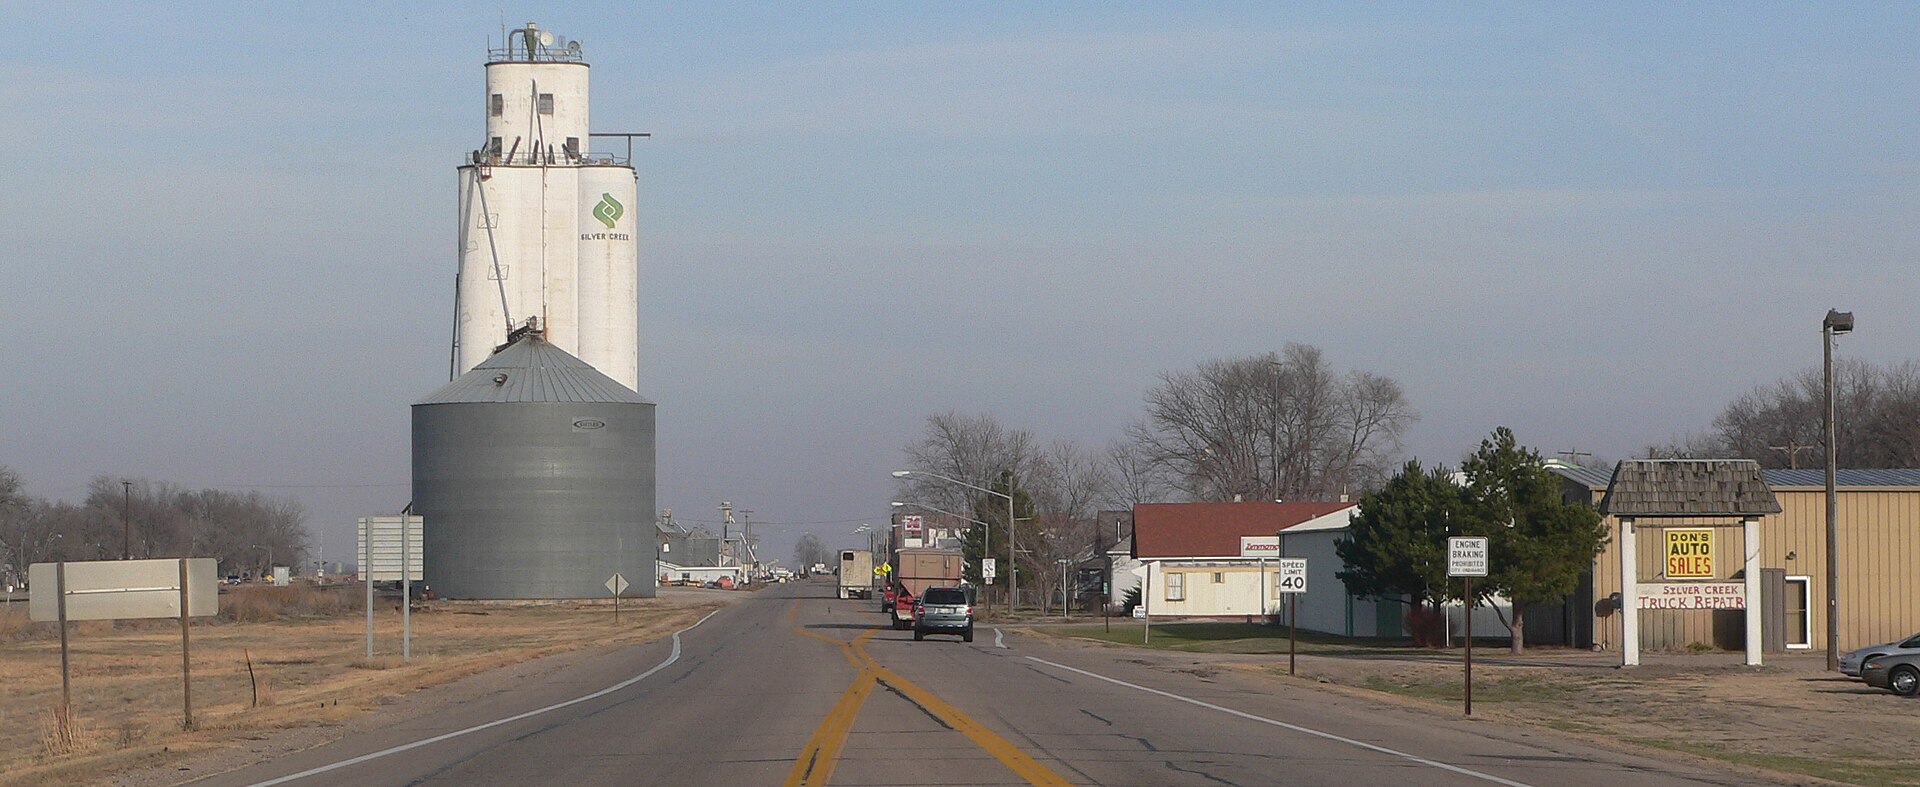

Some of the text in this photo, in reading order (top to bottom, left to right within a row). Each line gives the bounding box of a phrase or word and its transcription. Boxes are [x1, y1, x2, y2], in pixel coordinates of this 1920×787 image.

[581, 233, 629, 241] SILVER CREEK
[1670, 533, 1709, 542] DON'S
[1455, 540, 1481, 548] ENGINE
[1670, 543, 1710, 556] AUTO
[1452, 550, 1484, 559] BRAKING
[1281, 561, 1305, 569] SPEED
[1669, 557, 1711, 575] SALES
[1281, 576, 1304, 590] 40
[1663, 586, 1738, 595] SILVER CREEK
[1638, 596, 1744, 609] TRUCK REPAIR
